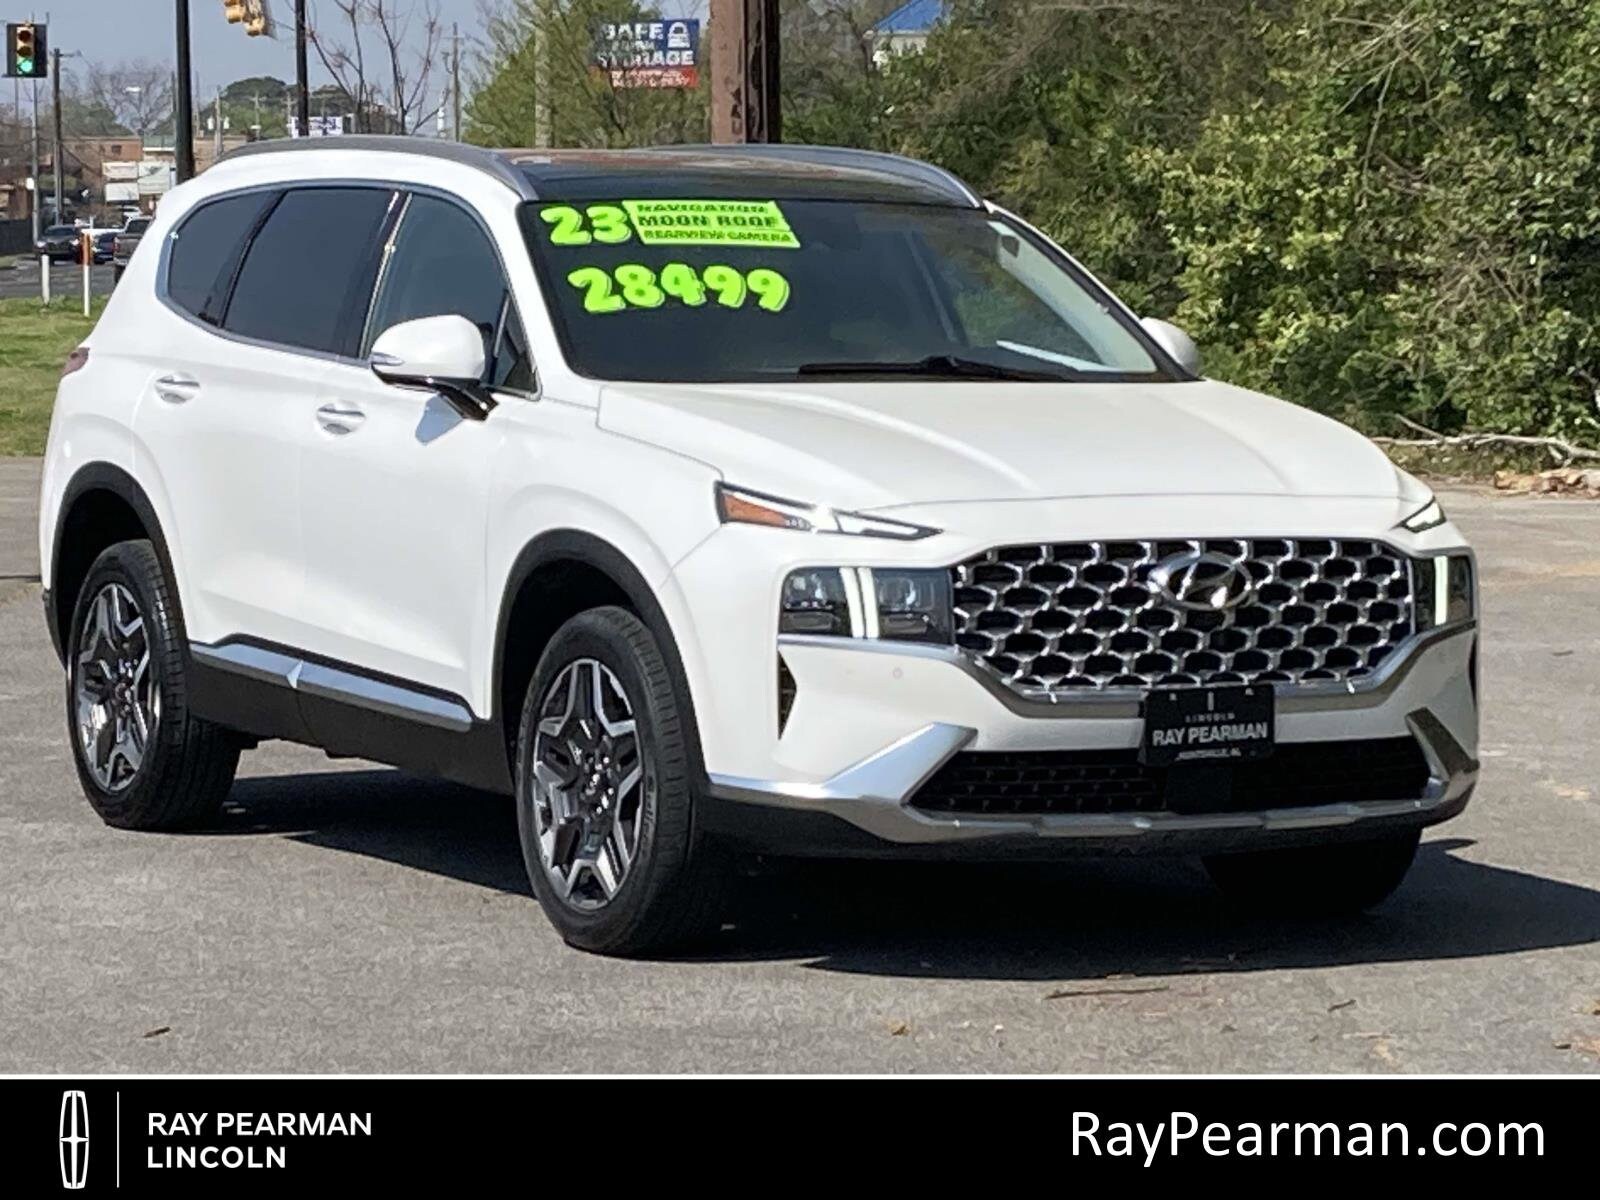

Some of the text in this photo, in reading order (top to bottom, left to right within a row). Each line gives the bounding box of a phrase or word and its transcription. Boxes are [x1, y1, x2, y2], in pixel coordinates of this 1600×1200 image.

[540, 206, 632, 244] 23
[638, 215, 778, 226] MOON ROOF
[727, 232, 793, 242] CAMERA
[567, 263, 790, 313] 28499
[1152, 721, 1268, 746] RAY PEARMAN
